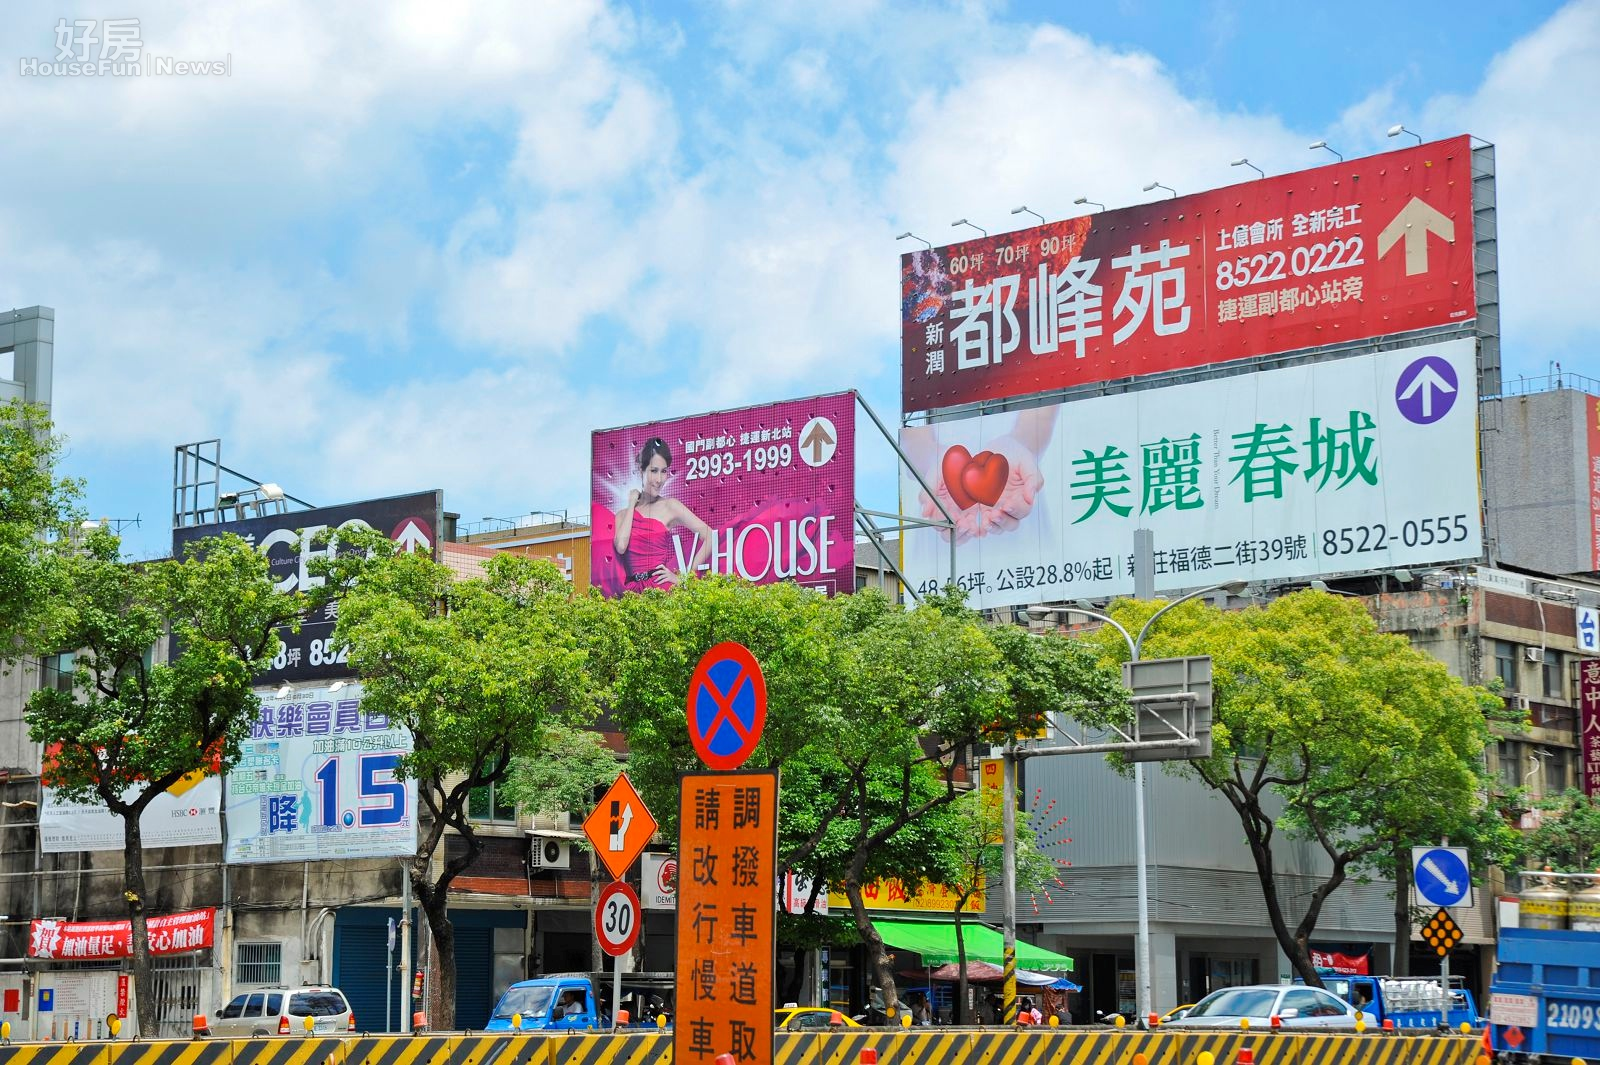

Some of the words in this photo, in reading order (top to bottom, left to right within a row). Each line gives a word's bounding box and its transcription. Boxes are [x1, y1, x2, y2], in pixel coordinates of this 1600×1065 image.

[1215, 217, 1284, 251] 上億會所
[1292, 204, 1362, 237] 全新完工
[950, 252, 984, 275] 60坪
[995, 243, 1030, 266] 70坪
[1040, 233, 1077, 257] 90坪
[1215, 251, 1286, 291] 8522
[1291, 236, 1364, 276] 0222
[950, 239, 1191, 370] 都峰苑
[1218, 276, 1364, 323] 捷運副都心站旁
[925, 321, 944, 375] 新潤
[740, 426, 792, 445] 捷運新北站
[685, 444, 792, 480] 2993-1999
[1070, 432, 1204, 525] 美麗
[1228, 410, 1378, 503] 春城
[672, 515, 836, 582] V-HOUSE
[1322, 514, 1468, 556] 8522-0555
[1579, 611, 1595, 647] 台
[267, 640, 301, 671] 8坪
[171, 810, 187, 818] HSBC
[267, 794, 298, 835] 降
[605, 900, 631, 936] 30
[655, 896, 675, 904] IDEMIT
[689, 788, 720, 1061] 請改行慢車
[729, 787, 761, 1063] 調撥車道取
